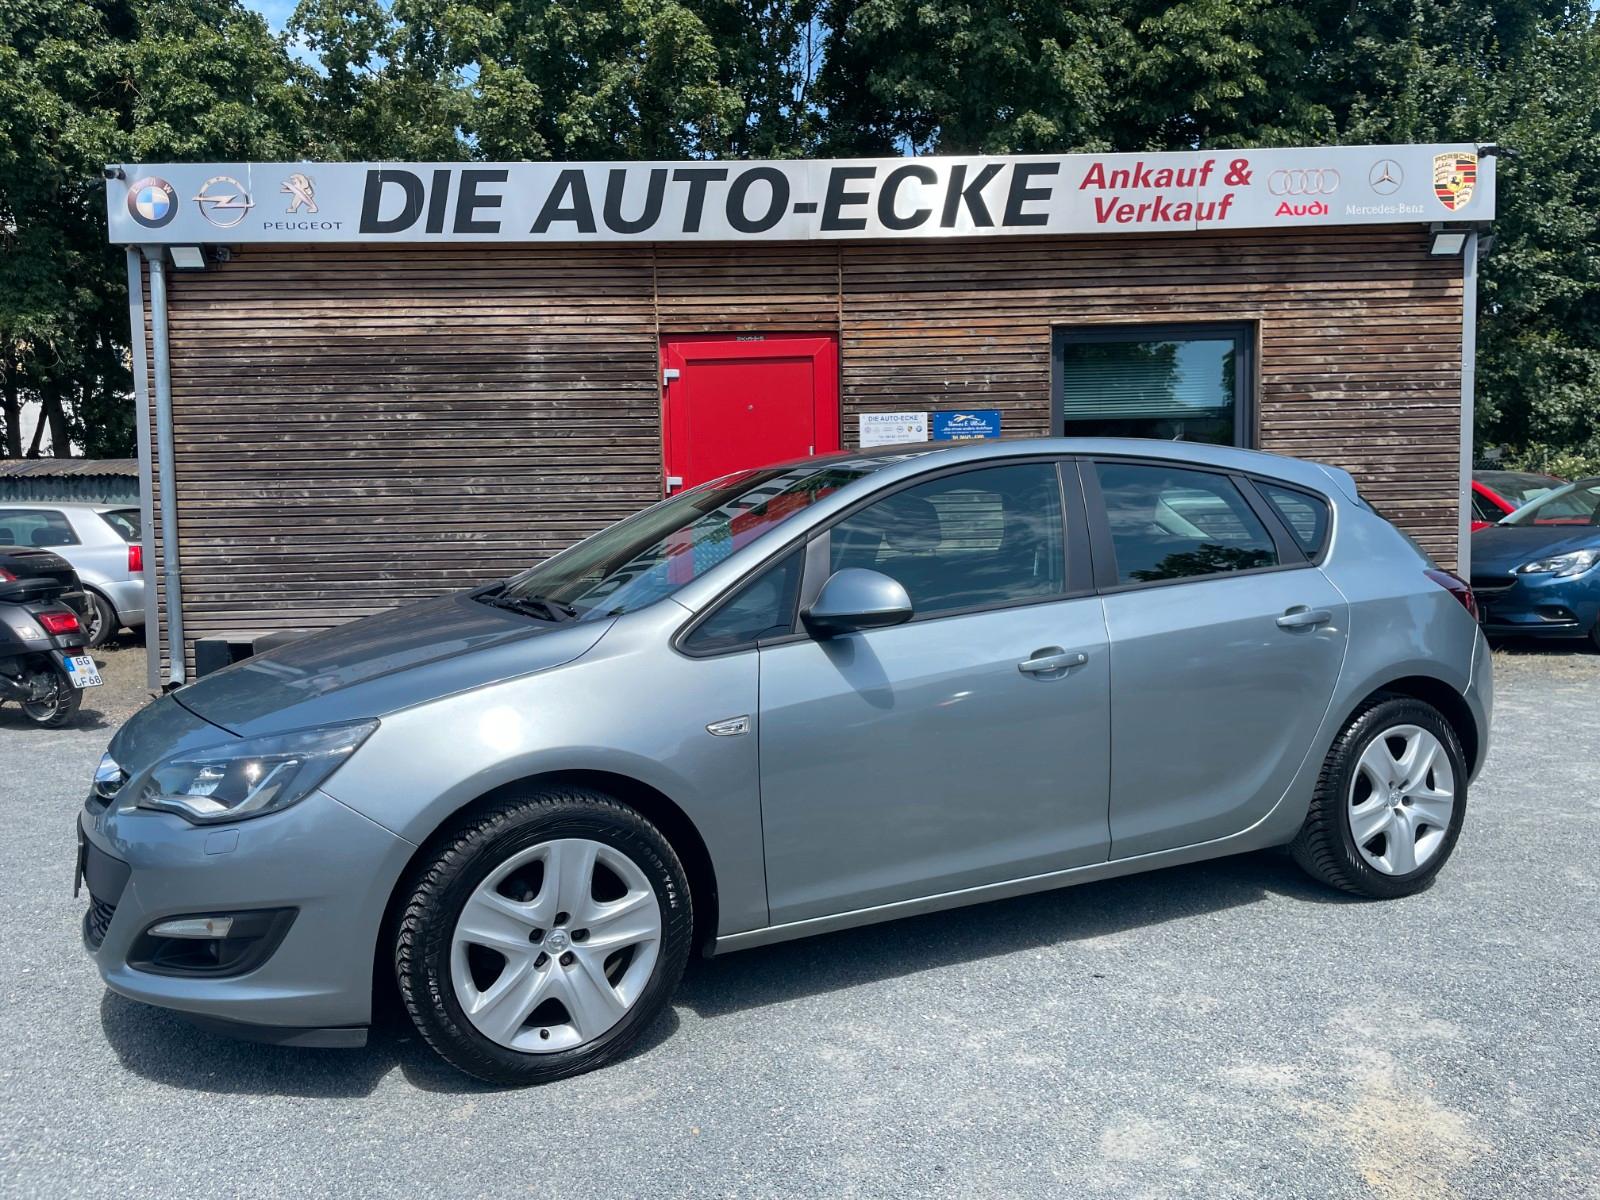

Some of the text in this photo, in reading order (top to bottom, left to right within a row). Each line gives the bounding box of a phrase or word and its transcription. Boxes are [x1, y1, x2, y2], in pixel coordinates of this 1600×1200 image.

[1434, 152, 1477, 162] PORSCHE
[1079, 158, 1254, 191] Ankauf &
[359, 161, 1060, 235] DIE AUTO-ECKE
[1094, 193, 1235, 225] Verkauf
[1274, 200, 1329, 216] Audi
[1345, 203, 1425, 216] Mercedes-Benz
[263, 221, 343, 230] PEUGEOT
[75, 656, 90, 666] GG
[74, 675, 101, 687] LF 68
